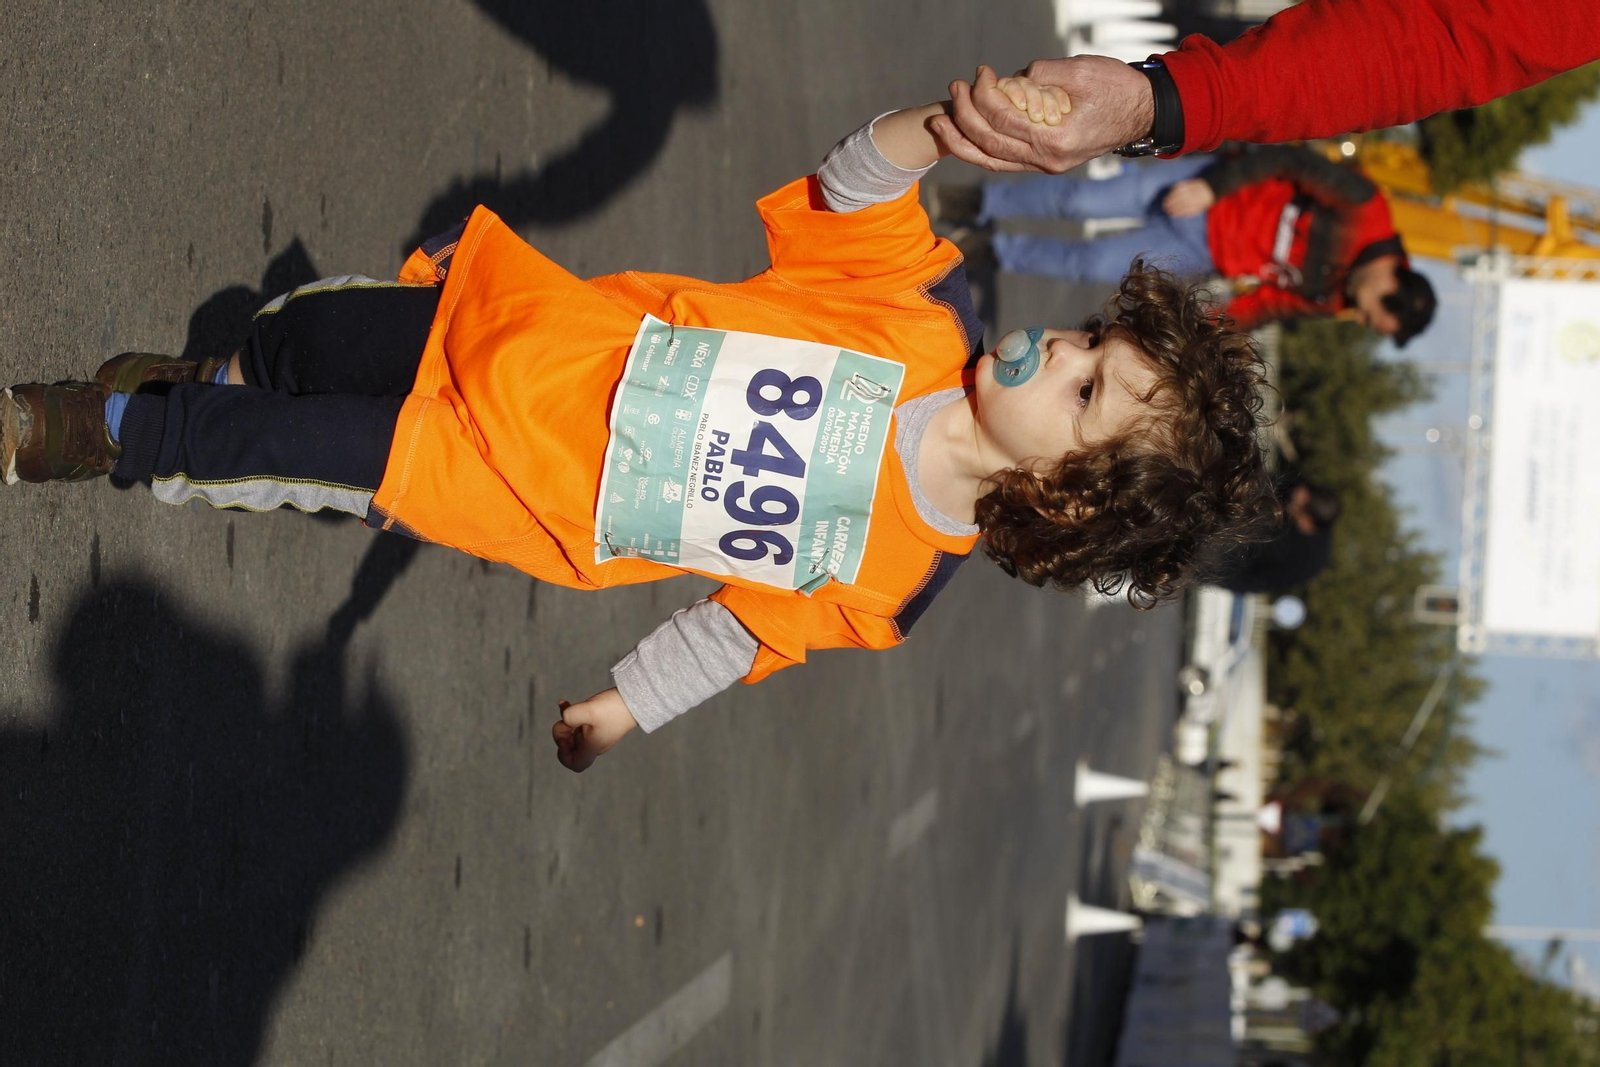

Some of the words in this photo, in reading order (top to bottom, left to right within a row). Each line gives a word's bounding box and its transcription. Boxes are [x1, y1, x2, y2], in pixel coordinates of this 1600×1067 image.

[641, 344, 657, 372] cajamar
[664, 338, 681, 366] Blanes
[690, 342, 710, 368] NEXA
[683, 374, 700, 400] CDX
[670, 426, 679, 448] CIUDAD
[696, 413, 710, 440] PABLO
[819, 406, 836, 454] 03/02/2019
[825, 408, 847, 465] ALMERÍA
[836, 411, 860, 475] MARATÓN
[854, 413, 873, 455] MEDIO
[672, 428, 687, 468] ALMERÍA
[700, 429, 730, 502] PABLO
[718, 368, 823, 566] 8496
[686, 472, 697, 509] NEGRILLO
[827, 516, 851, 575] CARRER
